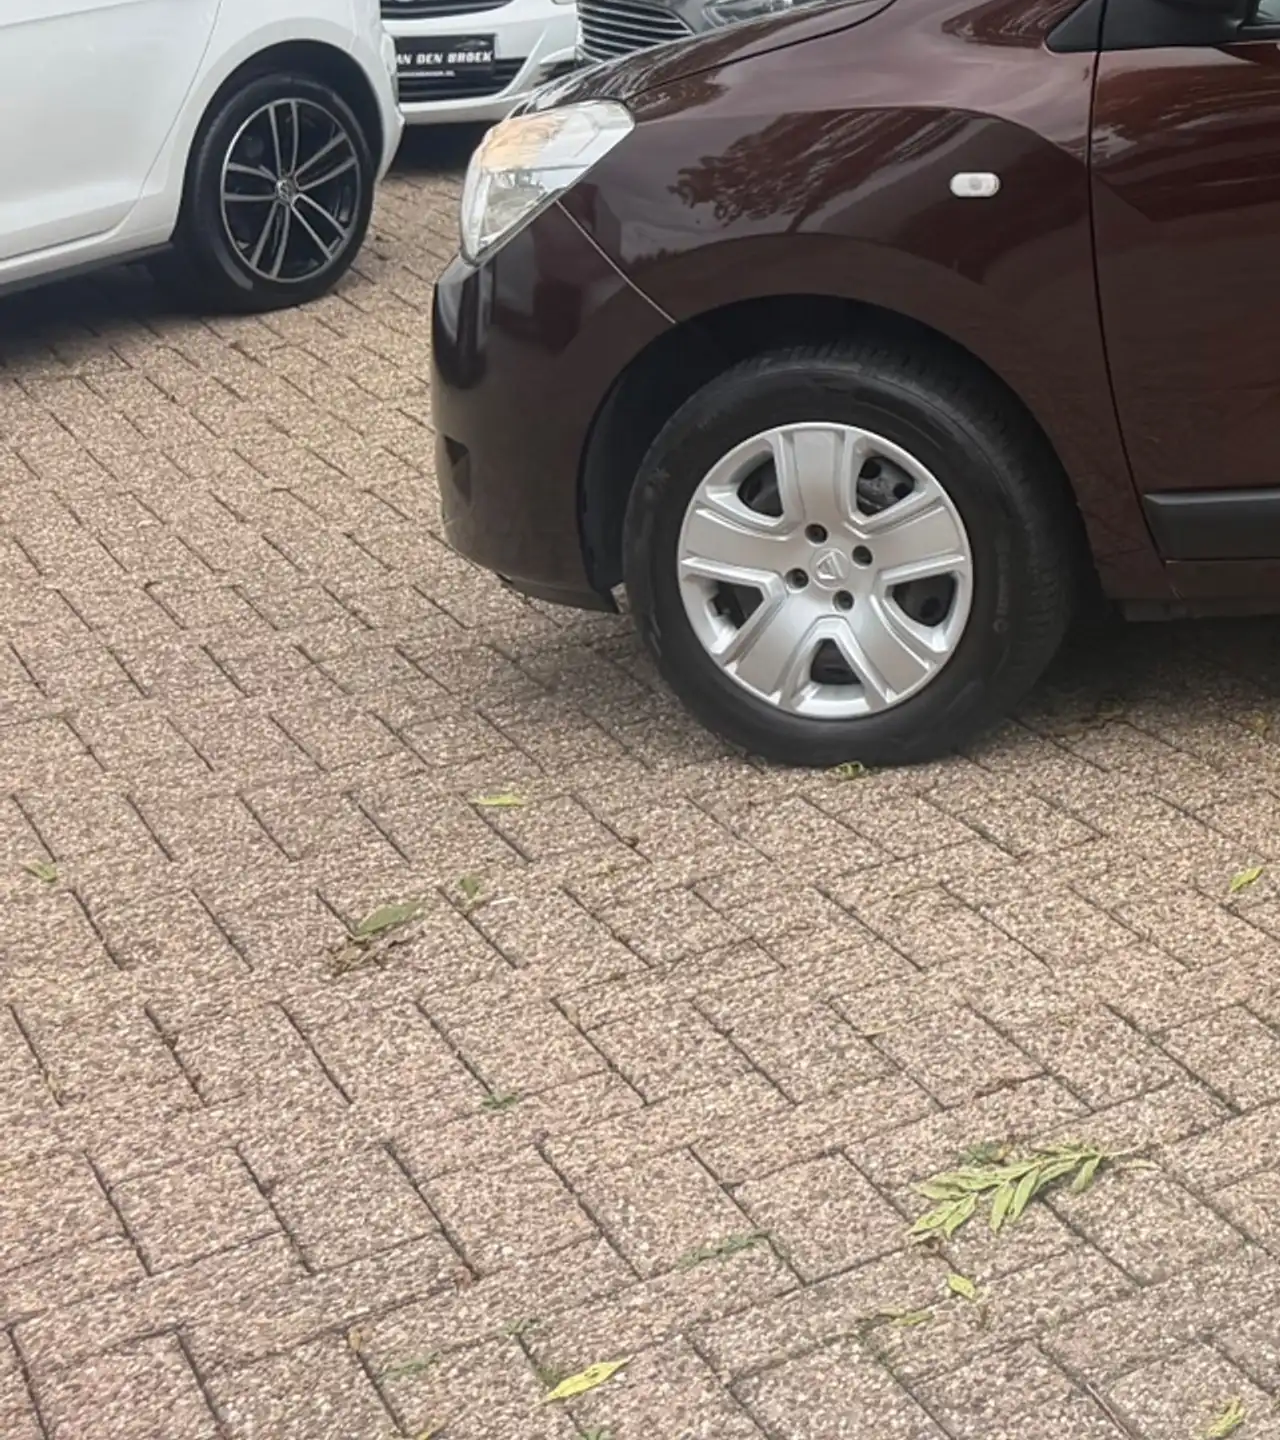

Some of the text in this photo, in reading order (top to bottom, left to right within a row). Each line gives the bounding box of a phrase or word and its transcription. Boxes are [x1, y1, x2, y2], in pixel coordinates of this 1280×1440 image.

[396, 51, 493, 65] AN DEN BROEK
